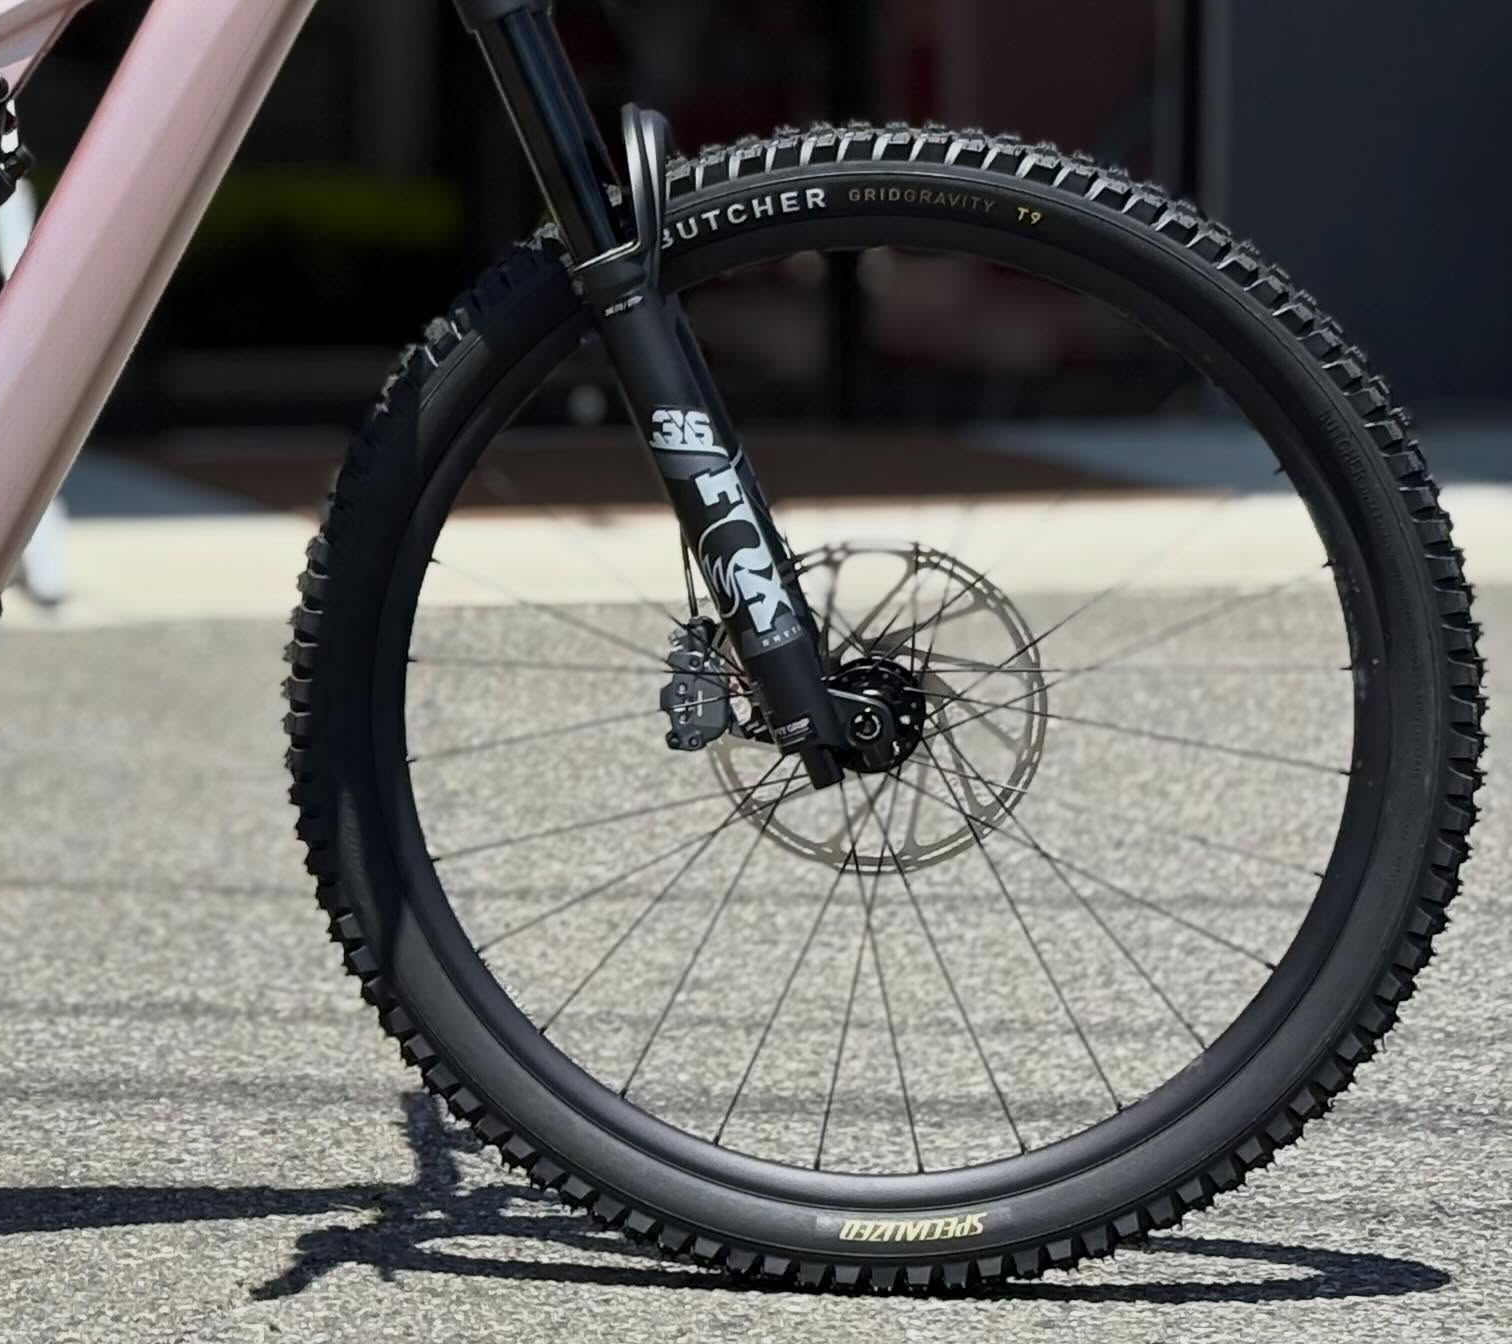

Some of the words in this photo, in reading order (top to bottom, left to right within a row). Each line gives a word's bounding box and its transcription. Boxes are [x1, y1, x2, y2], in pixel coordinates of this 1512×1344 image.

[1016, 207, 1042, 225] T9
[651, 409, 715, 447] 36
[840, 1212, 988, 1242] SPECIALIZED
